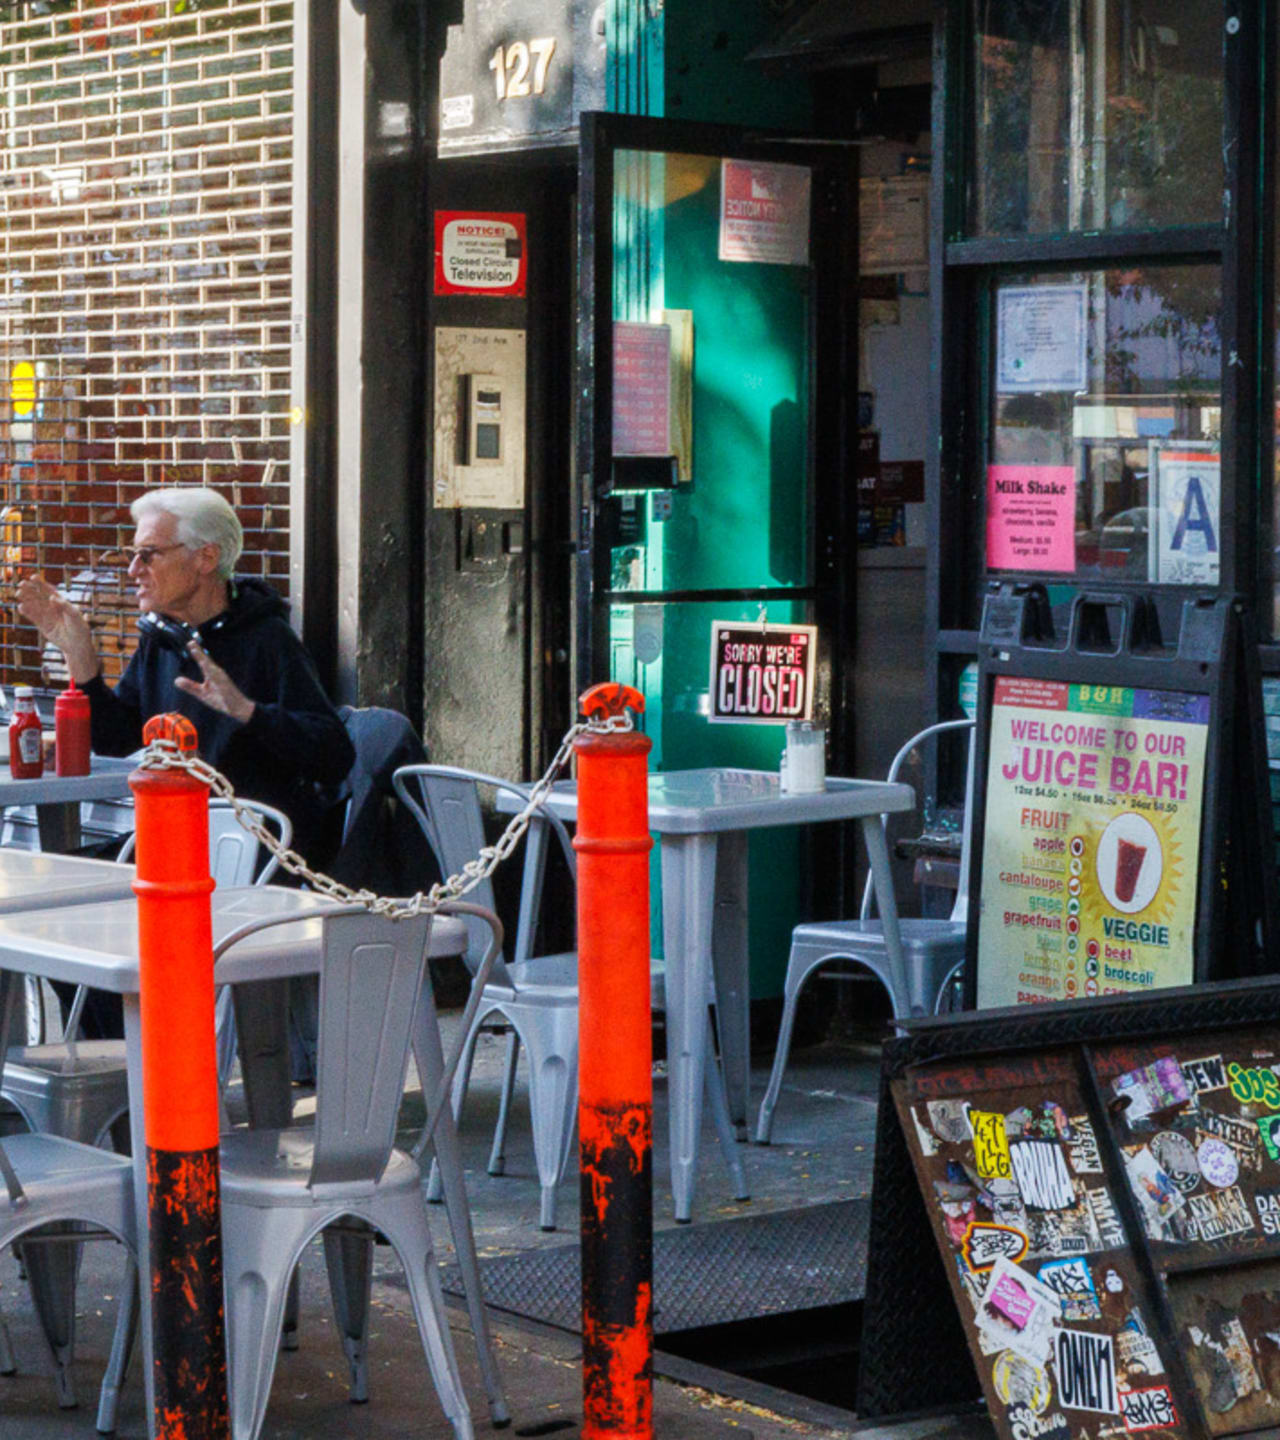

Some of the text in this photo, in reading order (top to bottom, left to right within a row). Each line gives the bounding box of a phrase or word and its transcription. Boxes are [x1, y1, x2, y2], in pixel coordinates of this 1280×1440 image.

[490, 37, 556, 100] 127
[449, 256, 512, 267] Closed Circuit
[450, 267, 512, 282] Television
[995, 480, 1067, 495] Milk Shake
[1170, 477, 1217, 552] A
[724, 643, 802, 665] SORRY WE'RE
[719, 663, 804, 715] CLOSED
[1011, 719, 1186, 756] WELCOME TO OUR
[1002, 747, 1189, 800] JUICE BAR!
[1021, 807, 1070, 829] FRUIT
[1033, 836, 1065, 854] apple
[999, 870, 1064, 893] cantaloupe
[1028, 895, 1062, 913] grape
[1003, 910, 1062, 930] grapefruit
[1103, 917, 1169, 945] VEGGIE
[1104, 944, 1132, 960] beet
[1018, 970, 1059, 990] orange
[1104, 964, 1154, 985] broccoli
